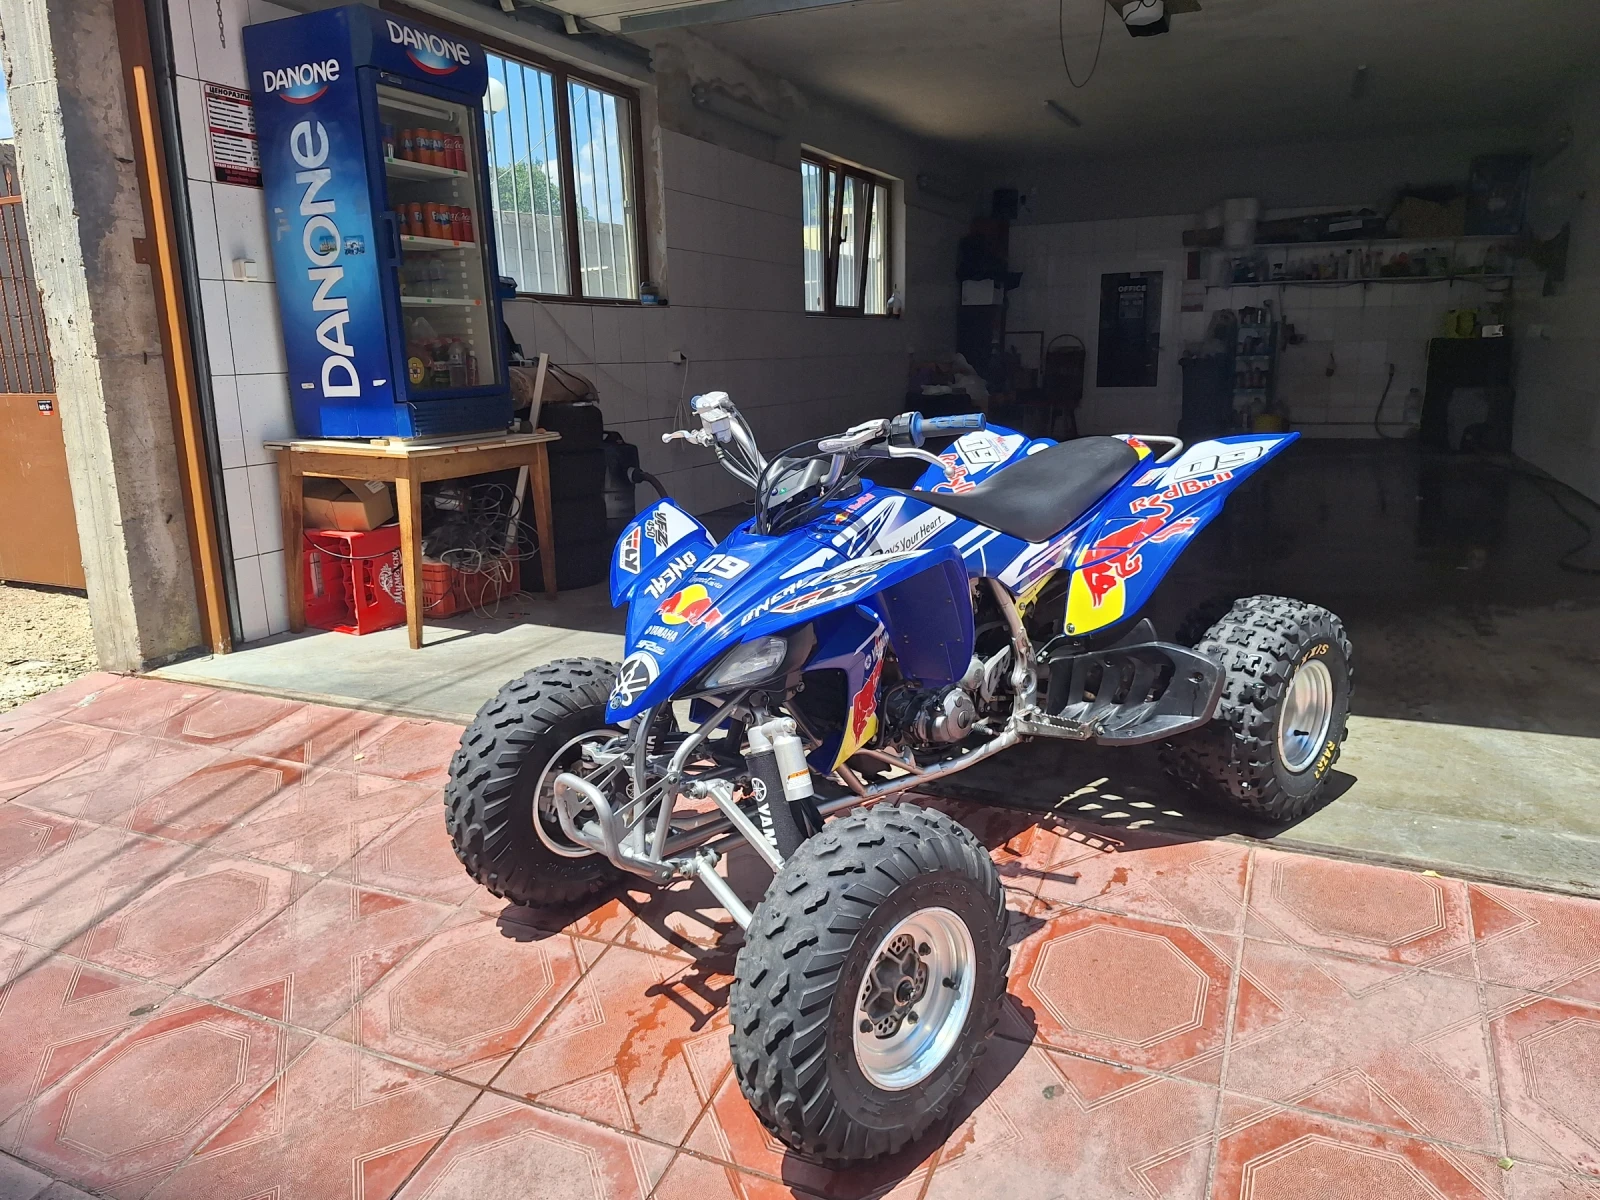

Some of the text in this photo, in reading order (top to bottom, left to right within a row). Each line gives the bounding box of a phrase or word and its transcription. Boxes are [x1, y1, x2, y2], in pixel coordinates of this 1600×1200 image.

[386, 19, 470, 65] DANONE
[263, 58, 340, 93] DANONE
[290, 120, 361, 397] DANONE
[1117, 284, 1147, 293] OFFICE
[1174, 446, 1263, 480] 09
[1130, 470, 1234, 513] Red Bull
[646, 520, 655, 538] 450
[654, 512, 668, 548] YFZ
[899, 532, 919, 551] Your
[919, 515, 942, 537] Heart
[693, 554, 750, 580] 09
[650, 626, 679, 643] YAMAHA
[758, 803, 779, 857] YAM
